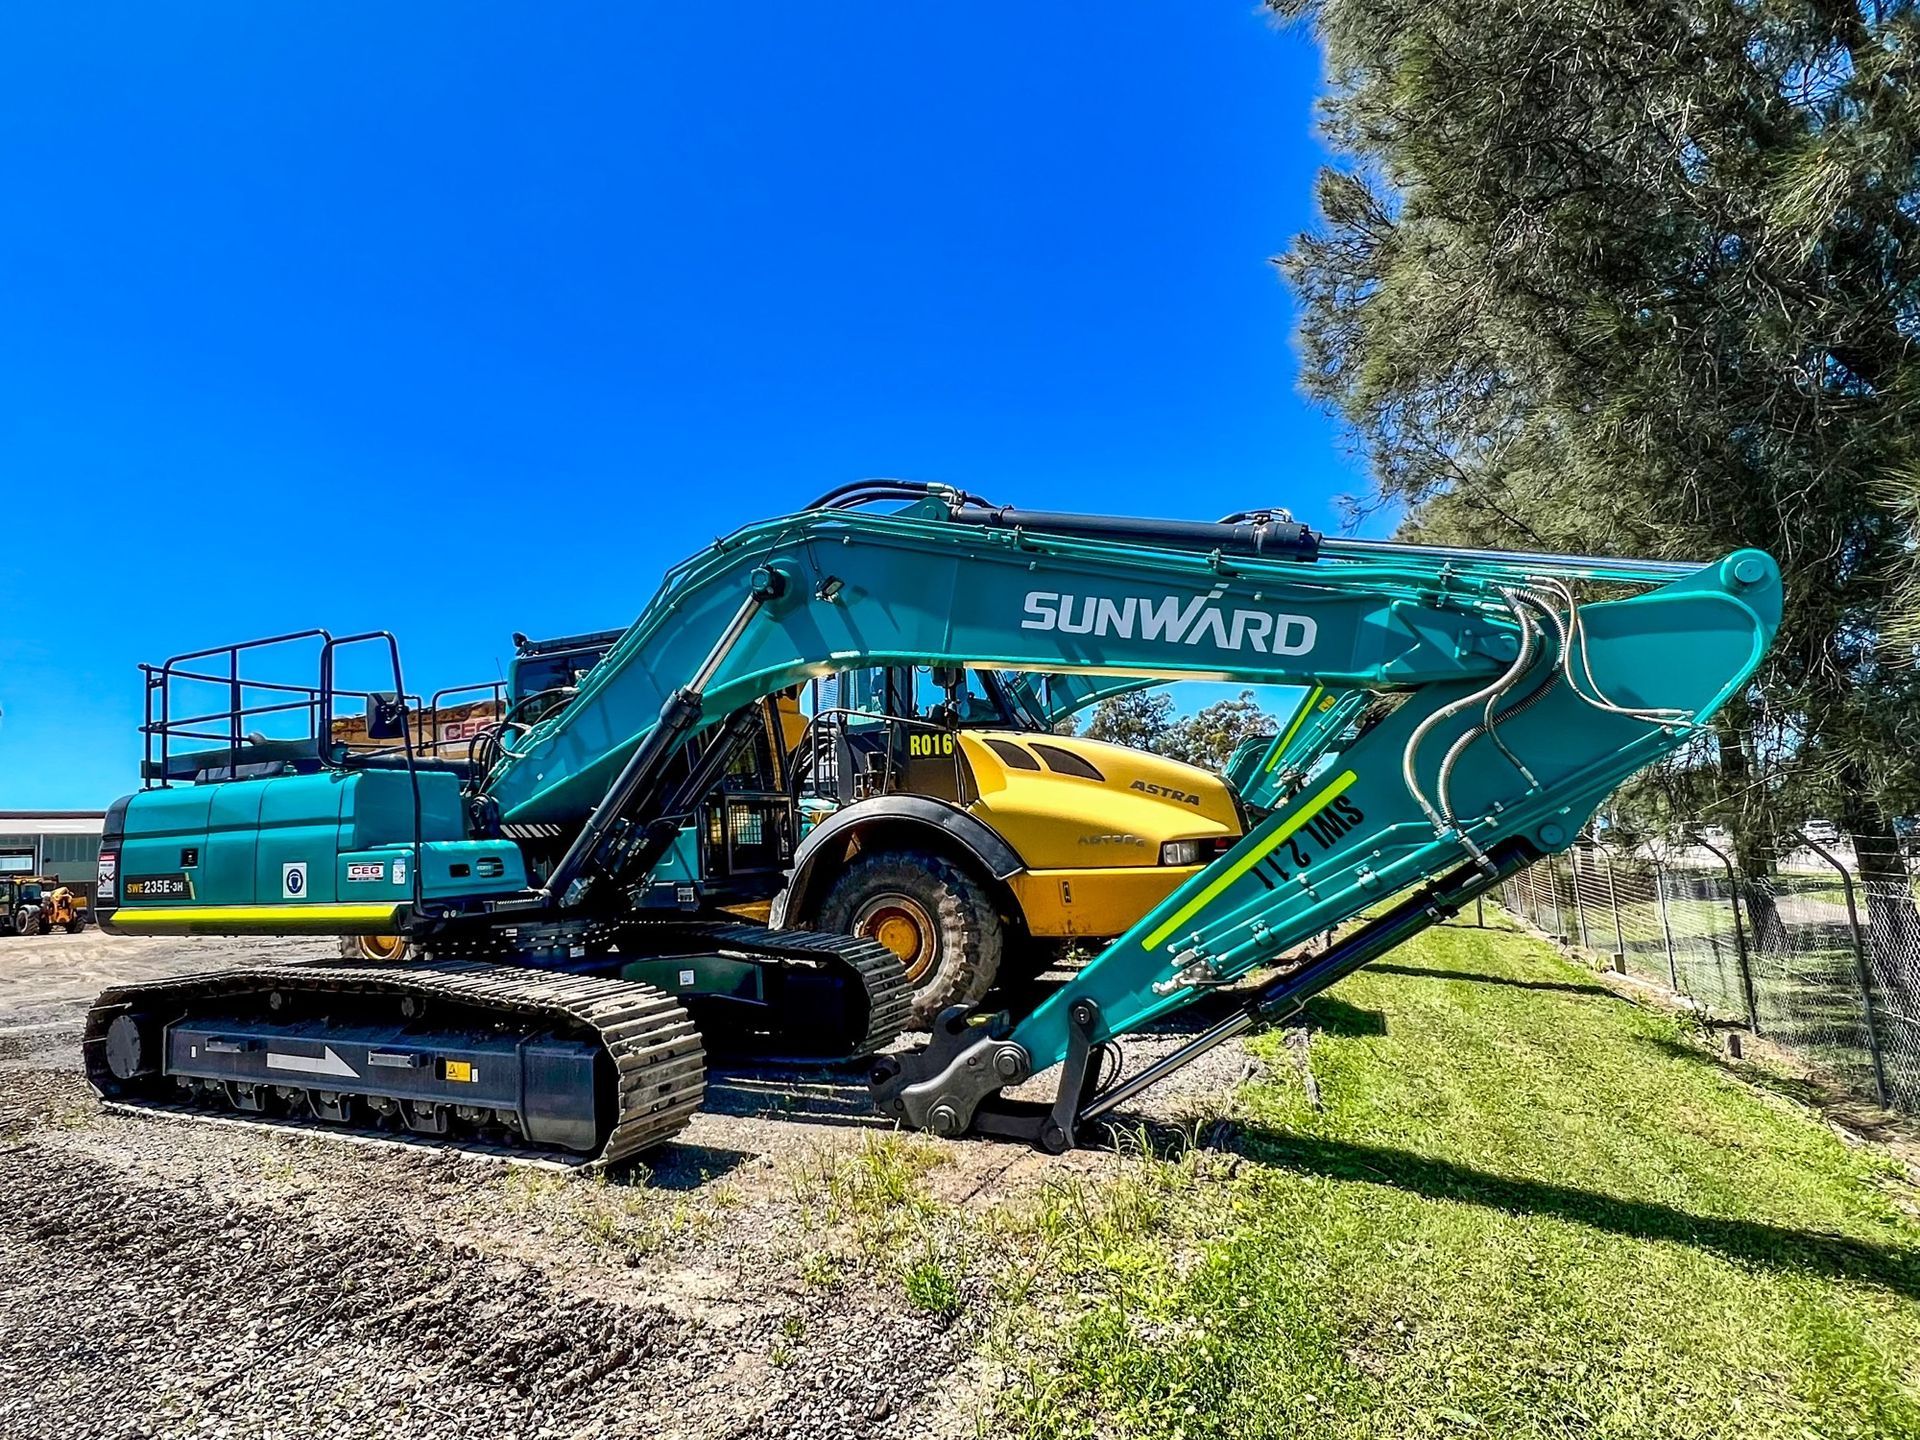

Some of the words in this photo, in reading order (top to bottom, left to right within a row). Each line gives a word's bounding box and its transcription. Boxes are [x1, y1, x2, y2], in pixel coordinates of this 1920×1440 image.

[1021, 583, 1317, 656] SUNWARD
[909, 733, 953, 756] R016
[1129, 779, 1200, 806] ASTRA
[1300, 794, 1365, 850] SWL
[351, 866, 380, 875] CEG
